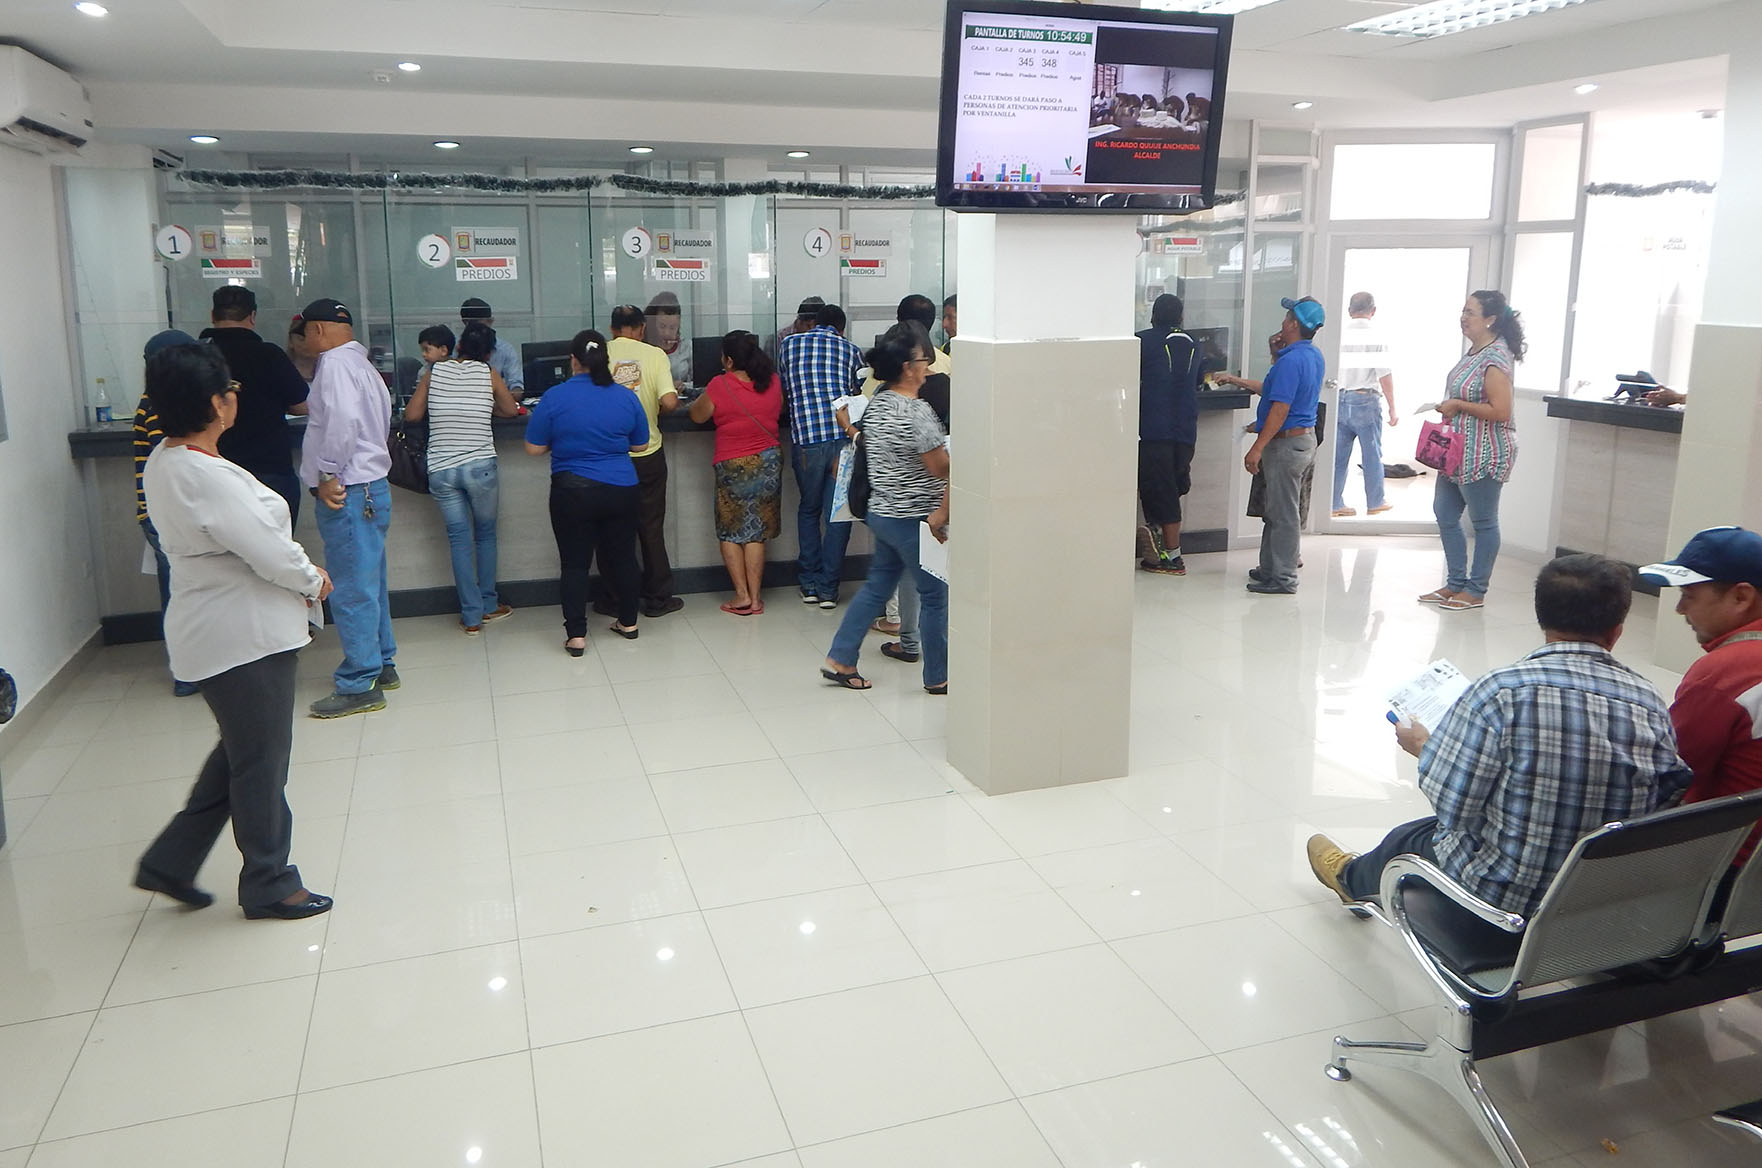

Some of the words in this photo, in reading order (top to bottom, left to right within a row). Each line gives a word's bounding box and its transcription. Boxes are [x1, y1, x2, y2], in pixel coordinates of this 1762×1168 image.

[974, 27, 1007, 38] PANTALLA
[1008, 29, 1017, 38] DE
[1018, 29, 1044, 40] TURNOS
[1046, 30, 1087, 42] 10:54:49
[1018, 57, 1034, 66] 345
[1042, 58, 1057, 68] 348
[1110, 141, 1138, 149] RICARDO
[168, 235, 181, 254] 1
[475, 238, 516, 246] RECAUDADOR
[631, 236, 642, 254] 3
[812, 236, 822, 252] 4
[428, 244, 440, 262] 2
[462, 268, 512, 280] PREDIOS
[660, 270, 706, 280] PREDIOS
